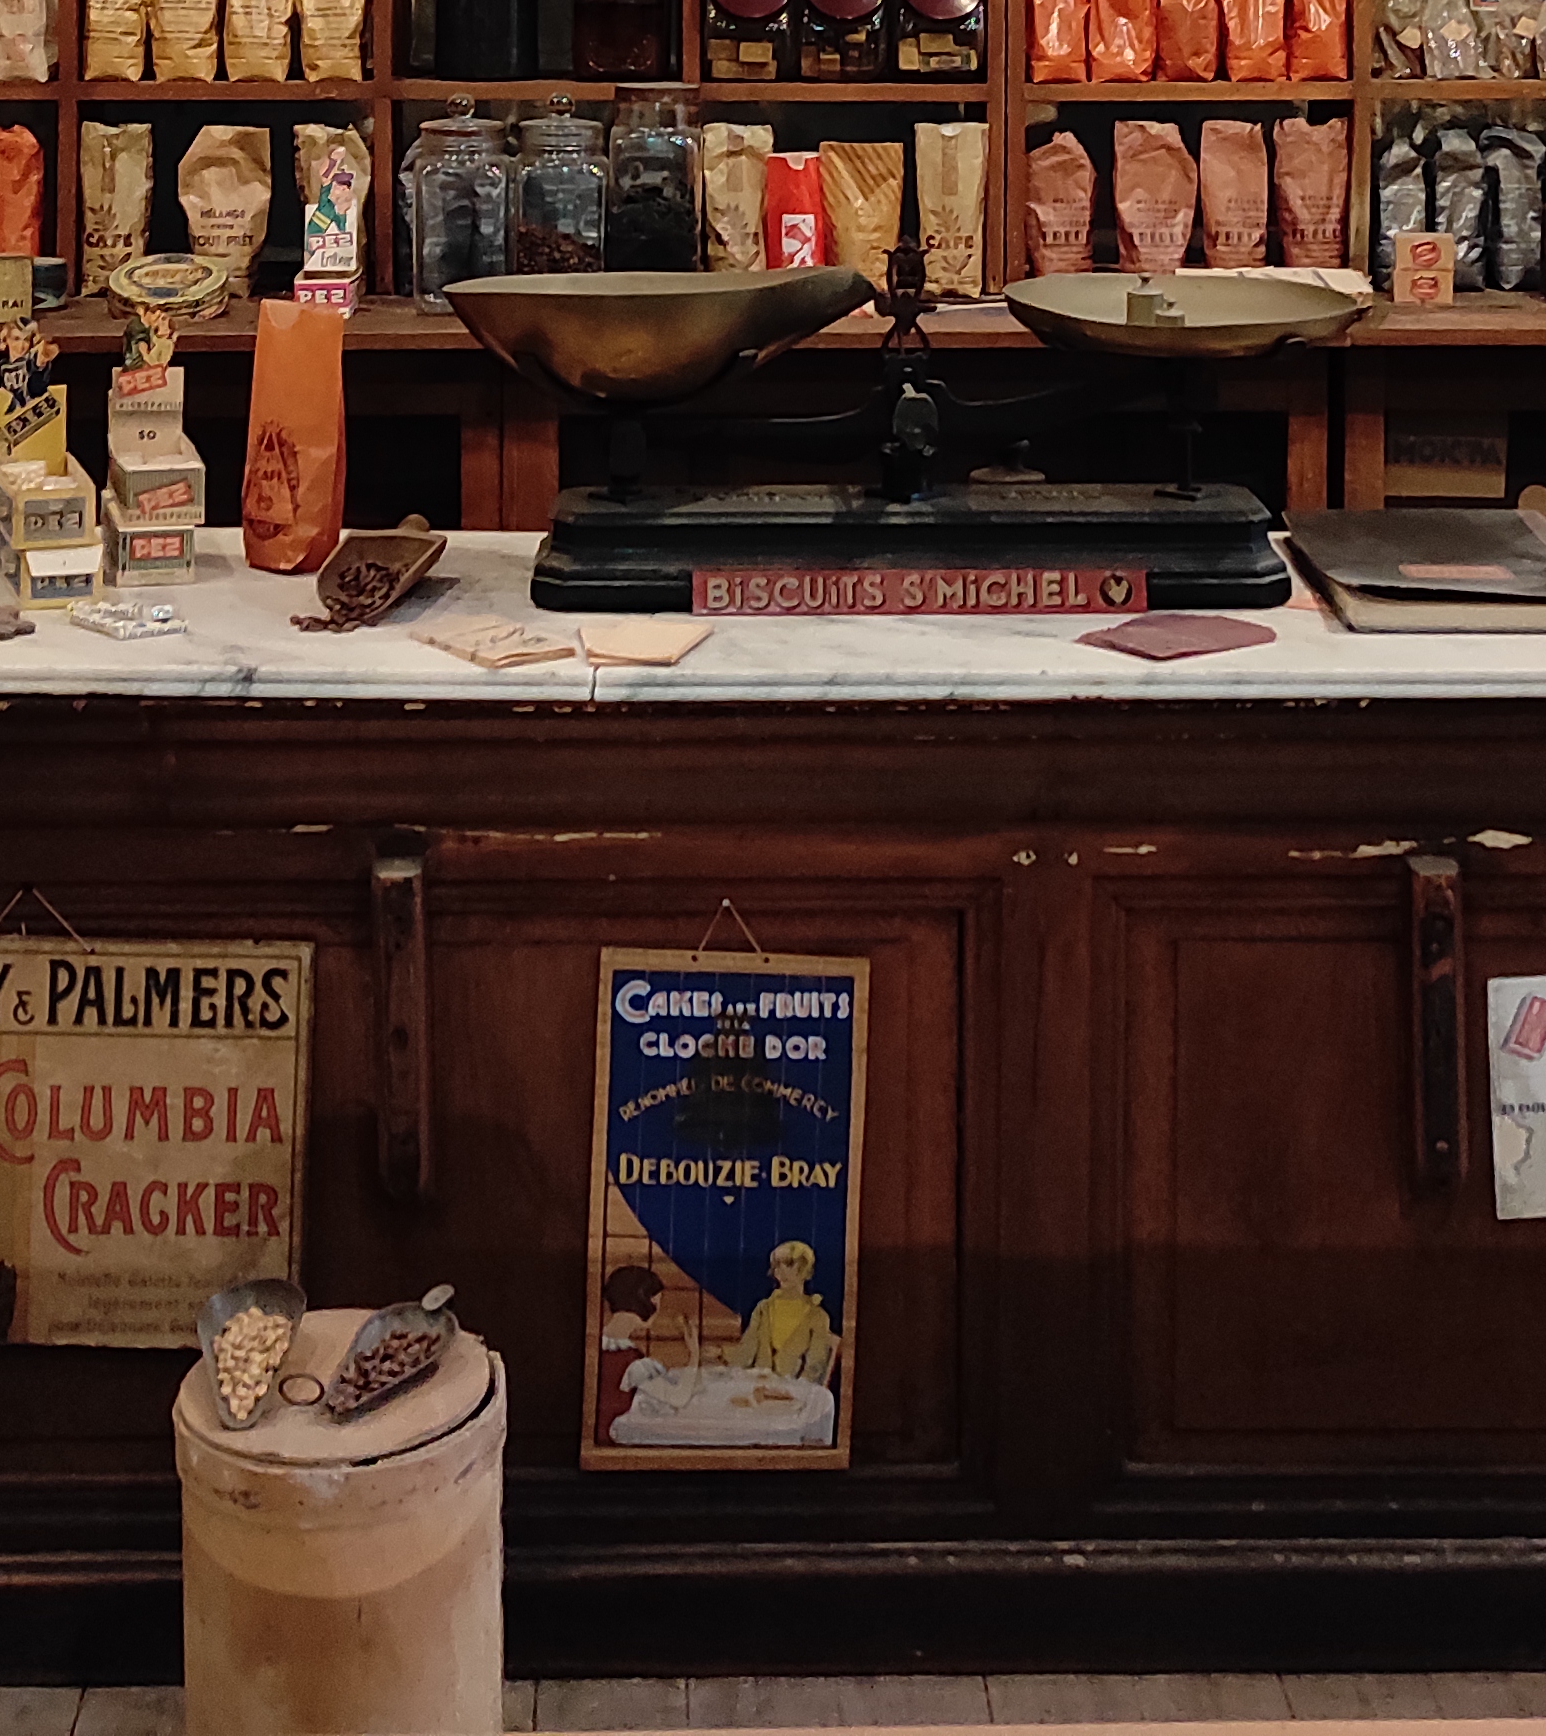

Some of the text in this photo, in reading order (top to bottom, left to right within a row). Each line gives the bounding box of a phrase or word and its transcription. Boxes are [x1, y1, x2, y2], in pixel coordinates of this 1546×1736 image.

[308, 233, 354, 251] PEZ
[297, 289, 345, 304] PEZ
[117, 366, 167, 395] PEZ
[138, 480, 194, 514] PEZ
[131, 536, 183, 558] PEZ
[12, 989, 35, 1026] &
[45, 958, 292, 1032] PALMERS
[614, 979, 724, 1023] CAKES
[758, 990, 850, 1020] FRUITS
[639, 1031, 755, 1058] CLOCHE
[741, 1075, 840, 1124] COMMERCY
[618, 1152, 843, 1189] DEBOUZIE BRAY
[42, 1158, 282, 1257] CRACKER
